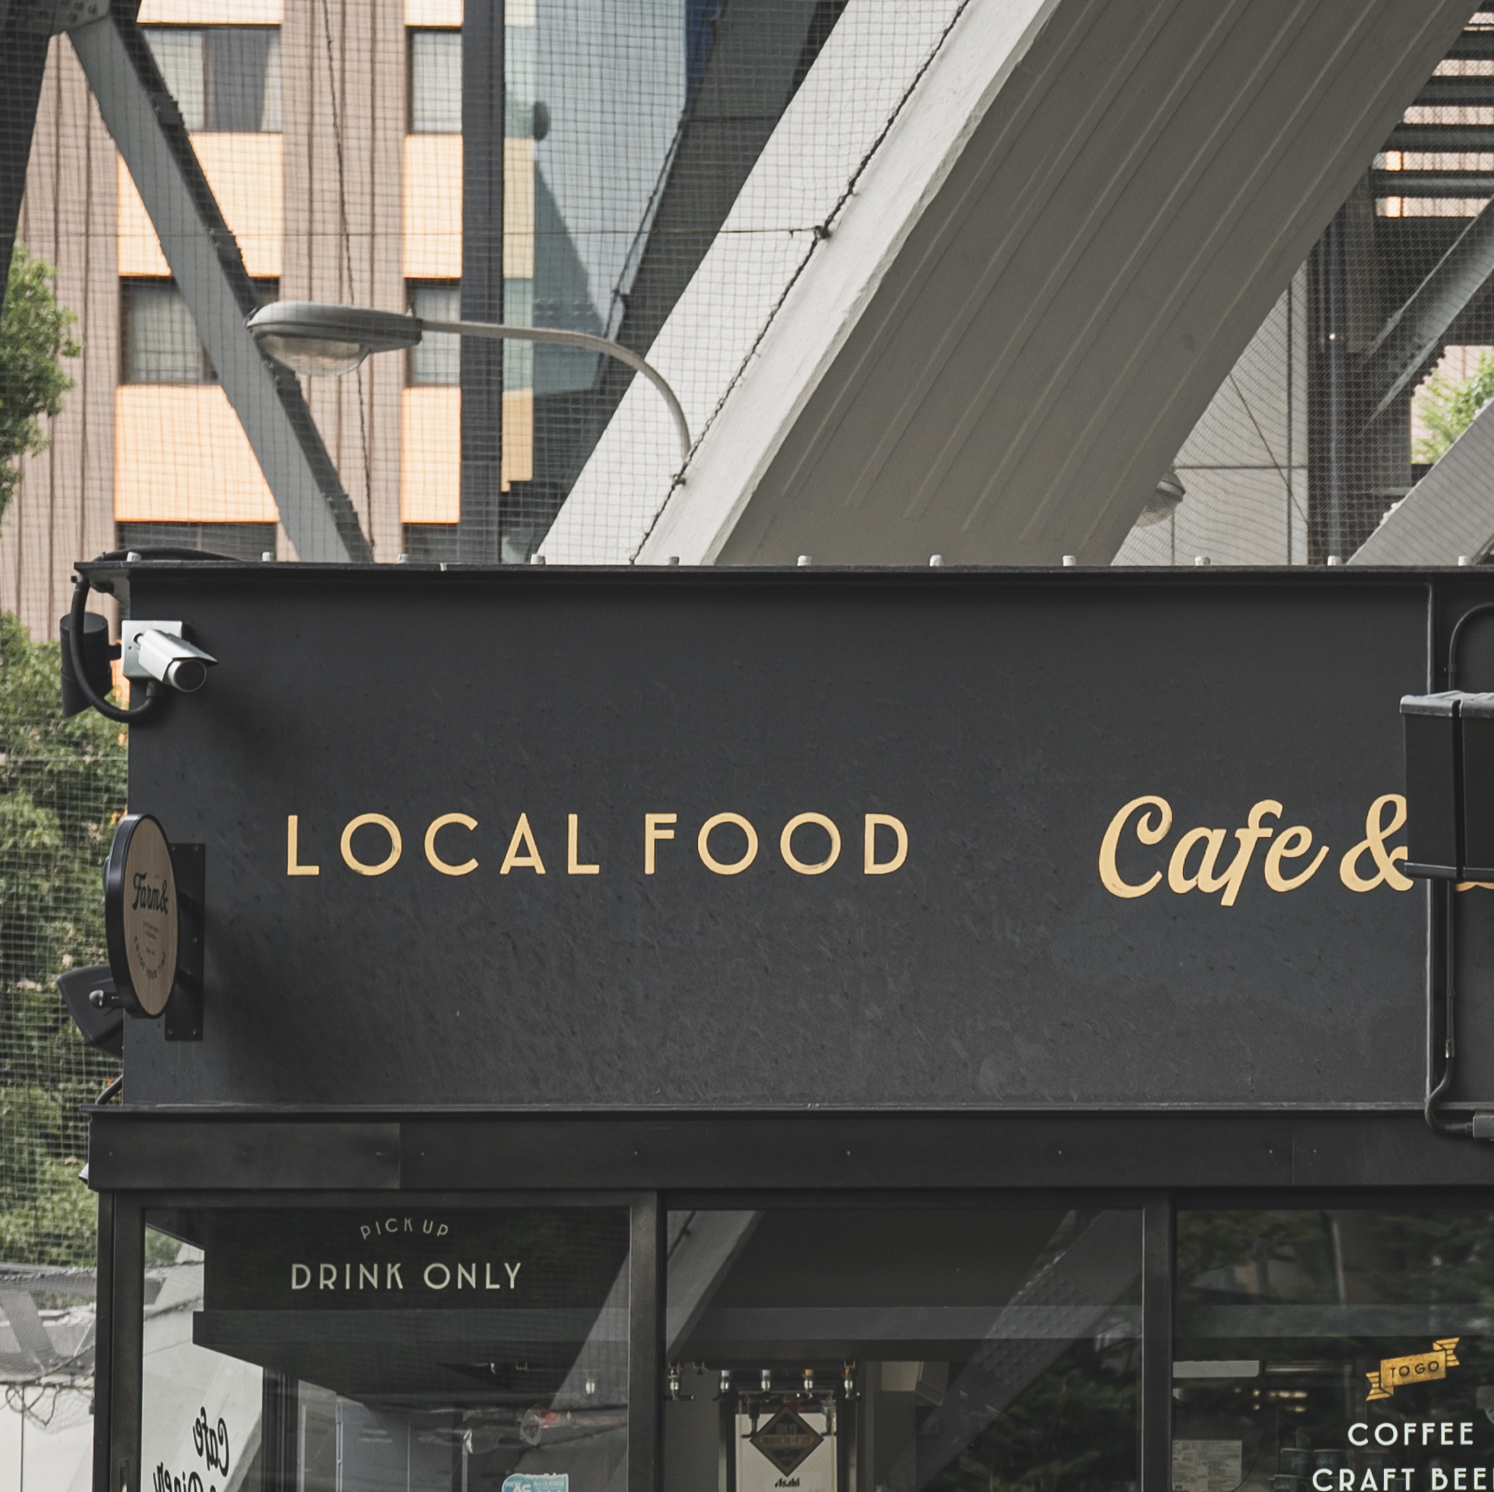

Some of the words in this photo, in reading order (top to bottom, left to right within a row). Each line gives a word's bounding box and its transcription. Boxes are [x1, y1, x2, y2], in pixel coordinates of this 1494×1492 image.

[287, 813, 601, 875] LOCAL
[645, 812, 909, 875] FOOD
[1099, 795, 1329, 906] Cafe
[1338, 794, 1413, 892] &
[132, 871, 169, 915] Farm&
[360, 1218, 413, 1240] PICK
[422, 1219, 449, 1238] UP
[291, 1263, 404, 1290] DRINK
[423, 1263, 522, 1290] ONLY
[1390, 1366, 1410, 1378] TO
[1414, 1360, 1440, 1375] GO
[1347, 1422, 1474, 1446] COFFEE
[774, 1478, 800, 1488] Asahi
[1312, 1468, 1415, 1491] CRAFT
